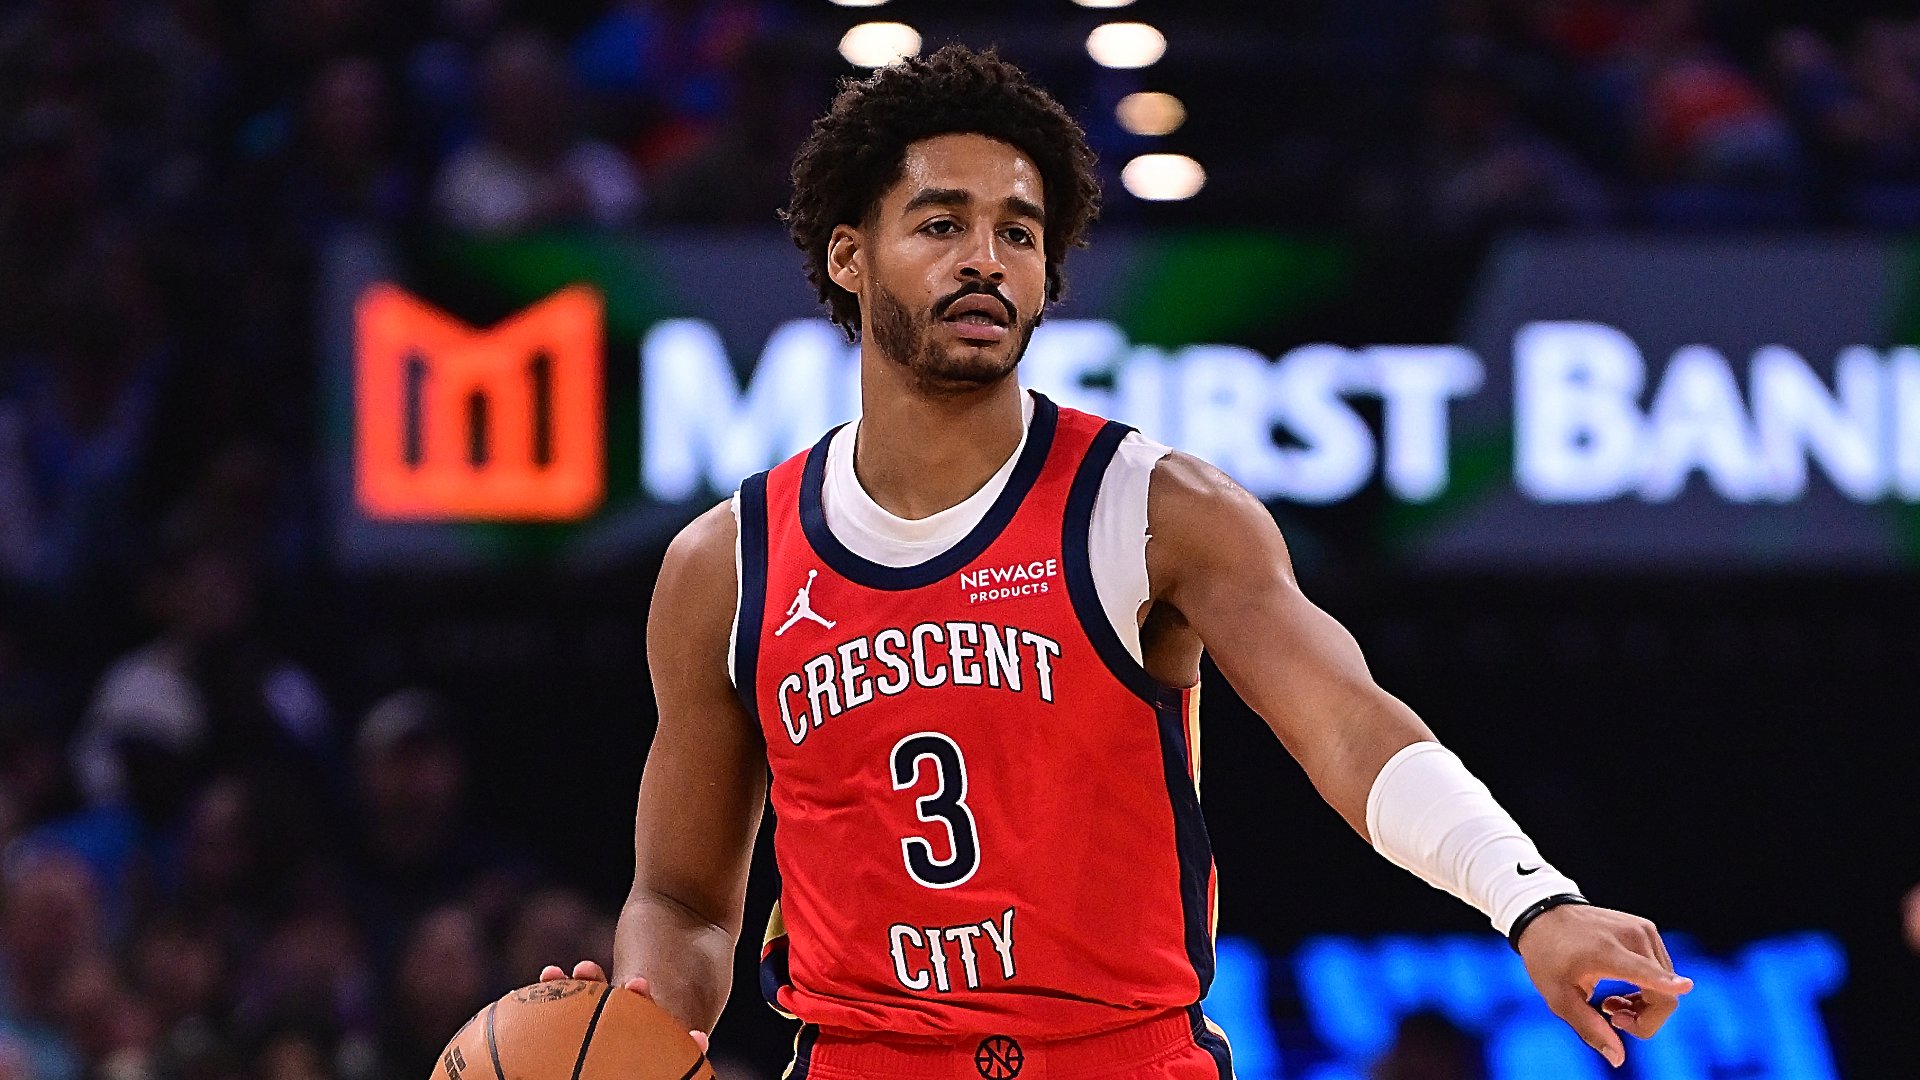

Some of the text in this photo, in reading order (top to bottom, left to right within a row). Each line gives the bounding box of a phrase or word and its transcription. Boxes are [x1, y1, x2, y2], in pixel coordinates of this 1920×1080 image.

[638, 317, 1485, 504] MFIRST
[960, 558, 1057, 590] NEWAGE
[969, 581, 1049, 604] PRODUCTS
[777, 621, 1062, 746] CRESCENT
[889, 731, 981, 889] 3
[888, 905, 1016, 992] CITY
